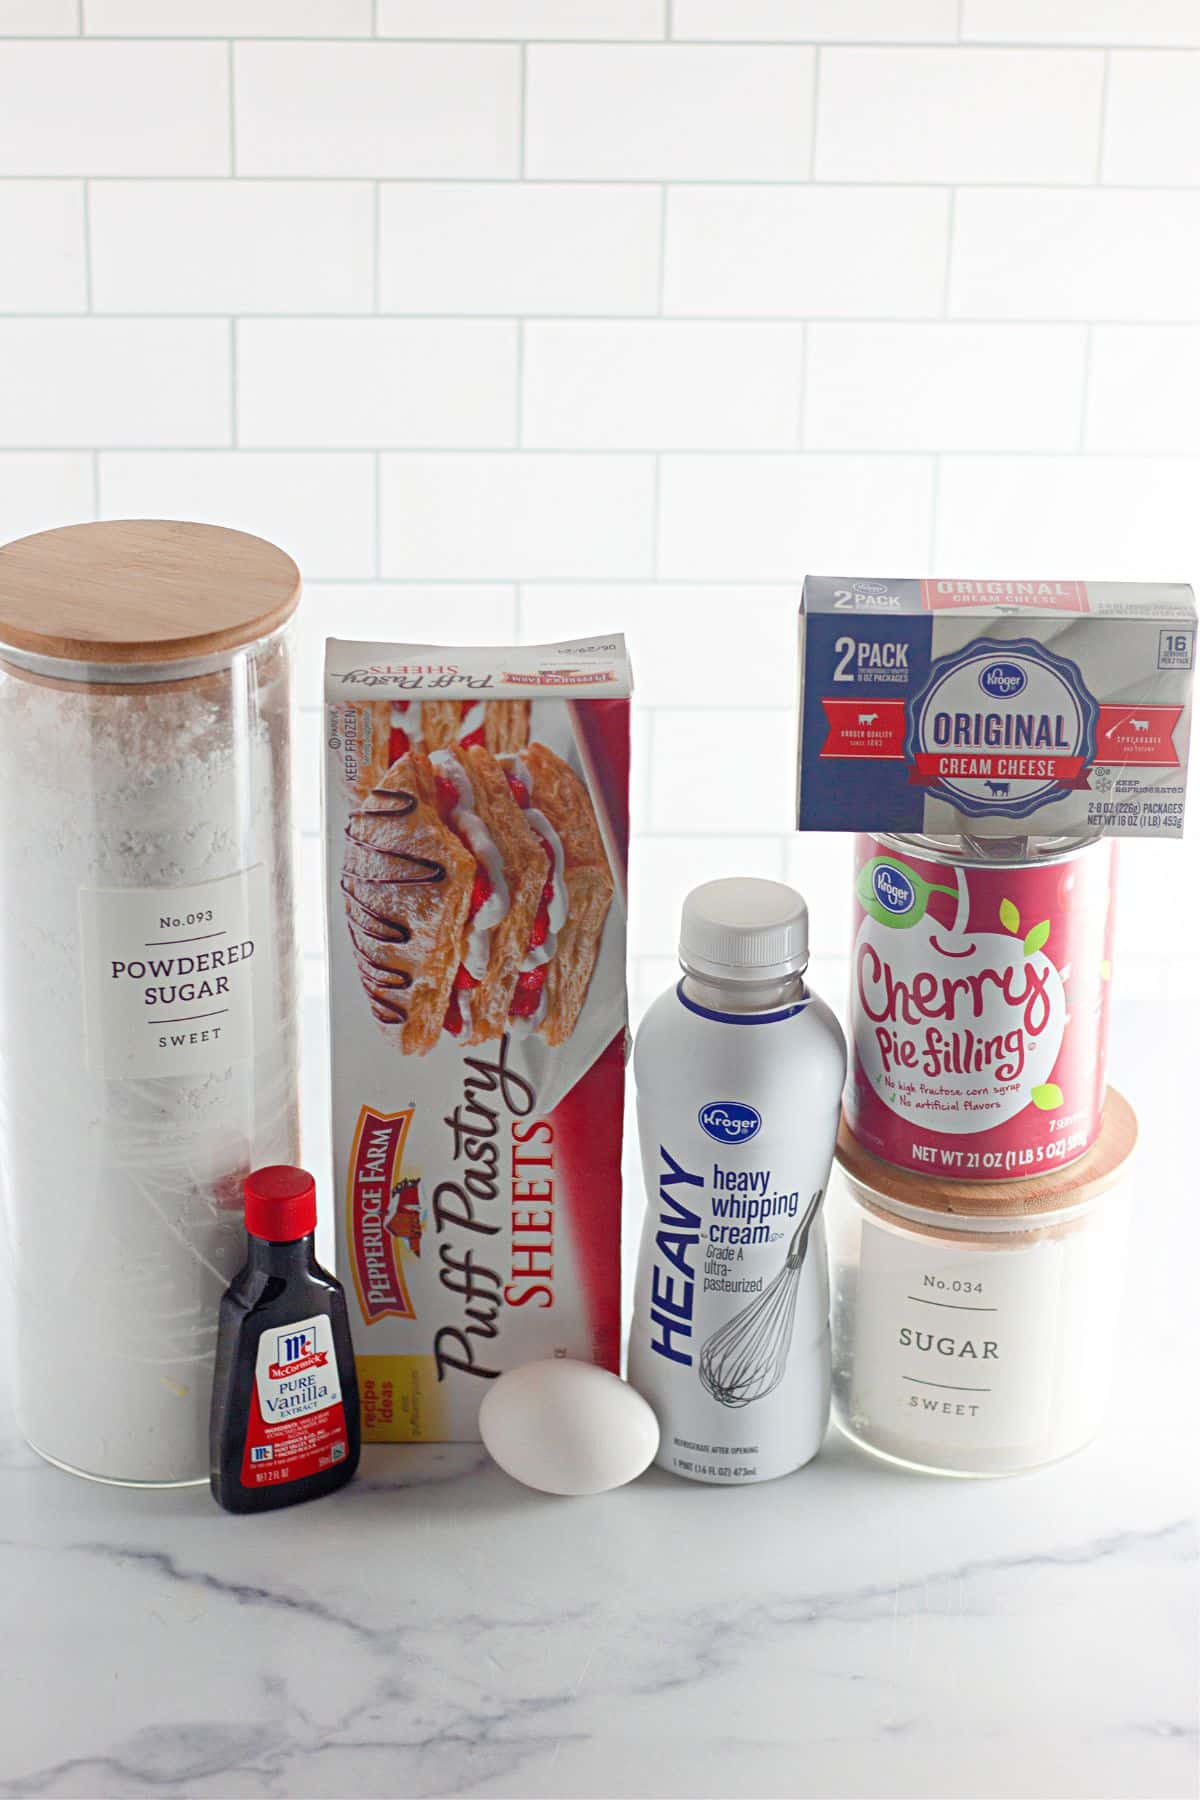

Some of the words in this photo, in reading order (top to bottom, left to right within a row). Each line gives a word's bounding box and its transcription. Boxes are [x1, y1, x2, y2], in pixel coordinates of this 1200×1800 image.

[834, 590, 854, 608] 2
[855, 594, 900, 607] PACK
[937, 581, 1071, 596] ORIGINAL
[1005, 595, 1056, 603] CHEESE
[1166, 636, 1186, 651] 16
[369, 665, 458, 675] SHEETS
[833, 637, 856, 681] 2
[857, 643, 909, 667] PACK
[331, 670, 423, 690] Pastry
[428, 674, 495, 689] Puff
[987, 668, 1021, 692] Kroger
[344, 710, 357, 752] FROZEN
[934, 712, 1070, 750] ORIGINAL
[345, 755, 357, 781] KEEP
[939, 757, 992, 775] CREAM
[998, 759, 1056, 777] CHEESE
[1088, 802, 1102, 813] 2-8
[1103, 802, 1114, 813] OZ
[1115, 802, 1141, 815] (226g)
[1143, 803, 1183, 814] PACKAGES
[1087, 815, 1103, 826] NET
[1103, 815, 1116, 826] WT
[1118, 815, 1126, 826] 16
[1128, 815, 1138, 826] OZ
[1148, 816, 1161, 828] LB)
[1162, 816, 1183, 829] 453g
[878, 871, 909, 905] Kroger
[159, 910, 214, 929] No.093
[111, 941, 255, 979] POWDERED
[144, 976, 231, 1005] SUGAR
[857, 942, 1050, 1037] Cherry
[158, 1028, 222, 1048] SWEET
[875, 1026, 920, 1072] Pie
[922, 1026, 1024, 1081] filling
[885, 1076, 895, 1088] No
[899, 1082, 916, 1094] high
[919, 1083, 963, 1096] fructose
[966, 1087, 988, 1096] corn
[993, 1082, 1021, 1096] syrup
[899, 1095, 912, 1107] No
[915, 1097, 960, 1110] artificial
[963, 1099, 1001, 1110] flavors
[703, 1109, 757, 1135] Kroger
[432, 1033, 536, 1236] Pastry
[359, 1127, 393, 1184] FARM
[912, 1144, 936, 1163] NET
[941, 1150, 964, 1168] WT
[967, 1152, 979, 1168] 21
[983, 1152, 1002, 1168] OZ
[1005, 1151, 1016, 1170] (1
[1019, 1148, 1034, 1165] LB
[1036, 1146, 1043, 1161] 5
[1046, 1139, 1066, 1161] OZ)
[713, 1164, 770, 1196] heavy
[503, 1118, 555, 1308] SHEETS
[712, 1192, 799, 1224] whipping
[361, 1186, 392, 1306] PEPPERIDGE
[709, 1224, 771, 1245] cream
[651, 1144, 704, 1367] HEAVY
[706, 1244, 735, 1261] Grade
[736, 1252, 744, 1261] A
[704, 1261, 732, 1277] ultra-
[704, 1277, 763, 1293] pasteurized
[923, 1274, 983, 1294] No.034
[433, 1241, 502, 1383] Puff
[899, 1327, 999, 1359] SUGAR
[271, 1354, 321, 1377] McCormick
[280, 1374, 317, 1394] PURE
[266, 1385, 328, 1412] Vanilla
[280, 1401, 318, 1417] EXTRACT
[361, 1380, 379, 1428] recipe
[377, 1381, 393, 1424] ideas
[909, 1396, 980, 1417] SWEET
[711, 1446, 729, 1454] AFTER
[731, 1446, 759, 1454] OPENING
